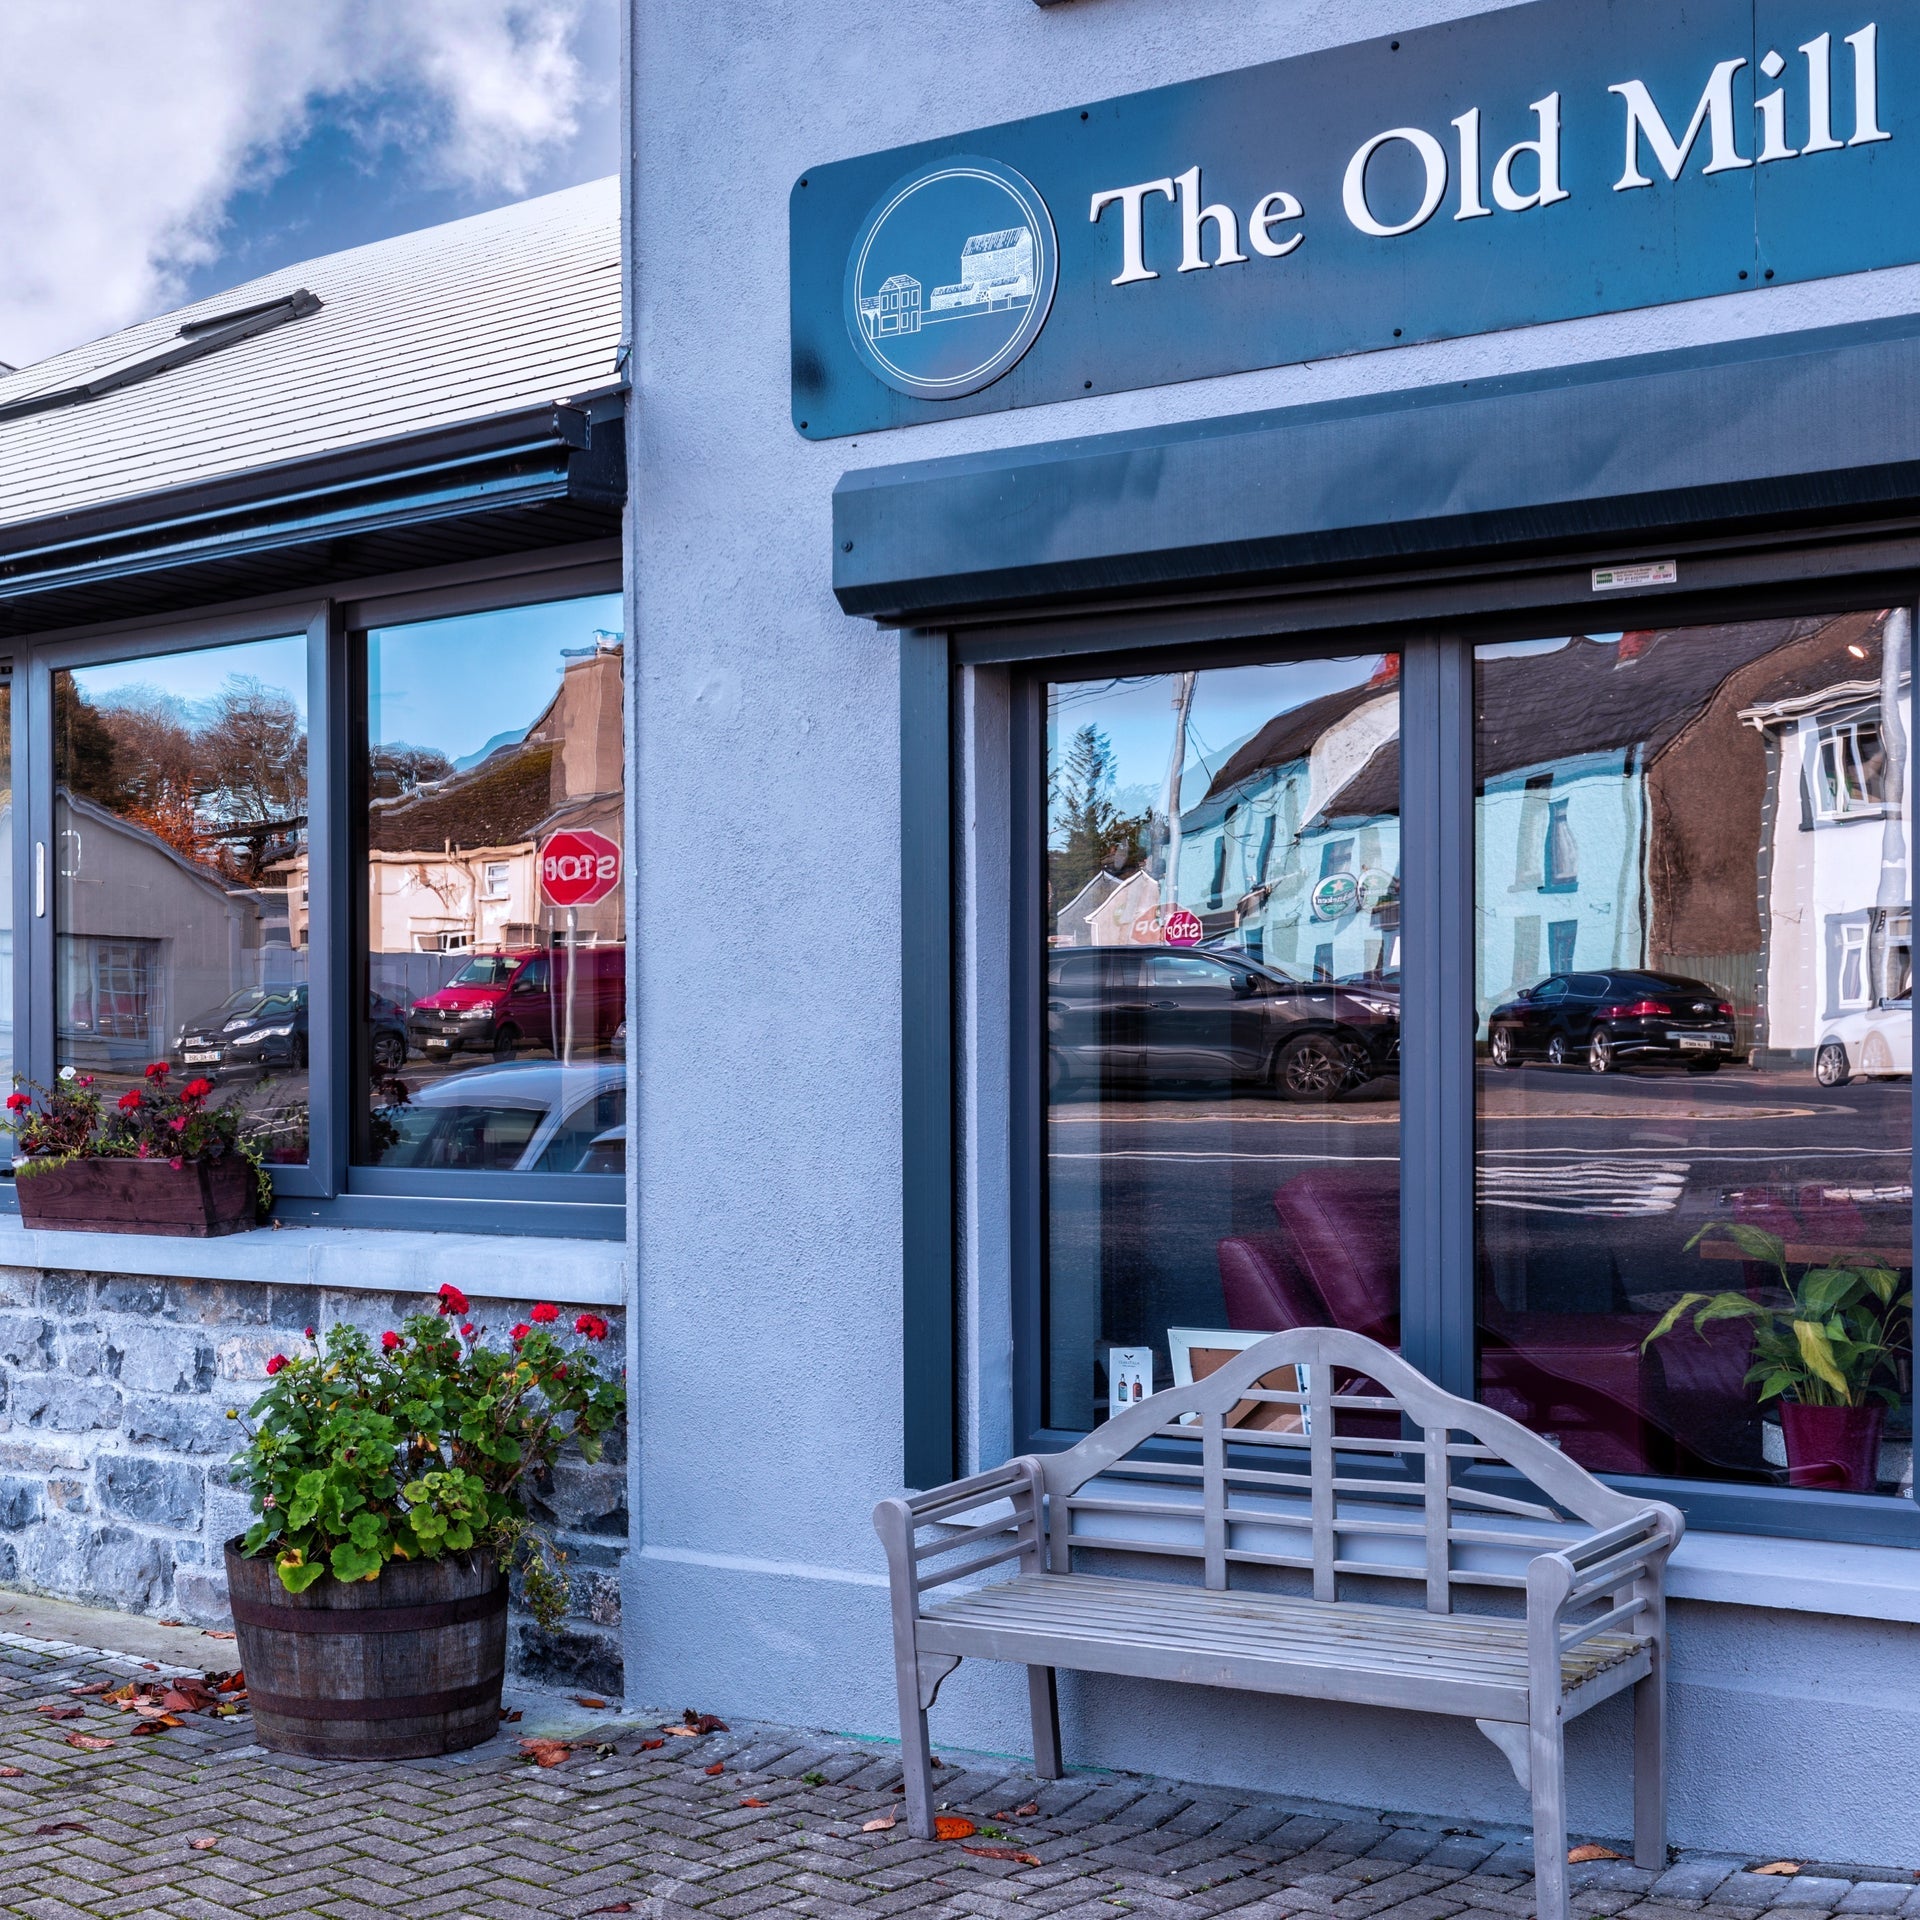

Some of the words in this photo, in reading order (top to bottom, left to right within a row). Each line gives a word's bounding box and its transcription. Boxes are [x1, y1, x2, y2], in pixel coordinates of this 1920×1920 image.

[1090, 164, 1305, 287] The
[1341, 91, 1570, 238] Old
[1607, 22, 1893, 192] Mill
